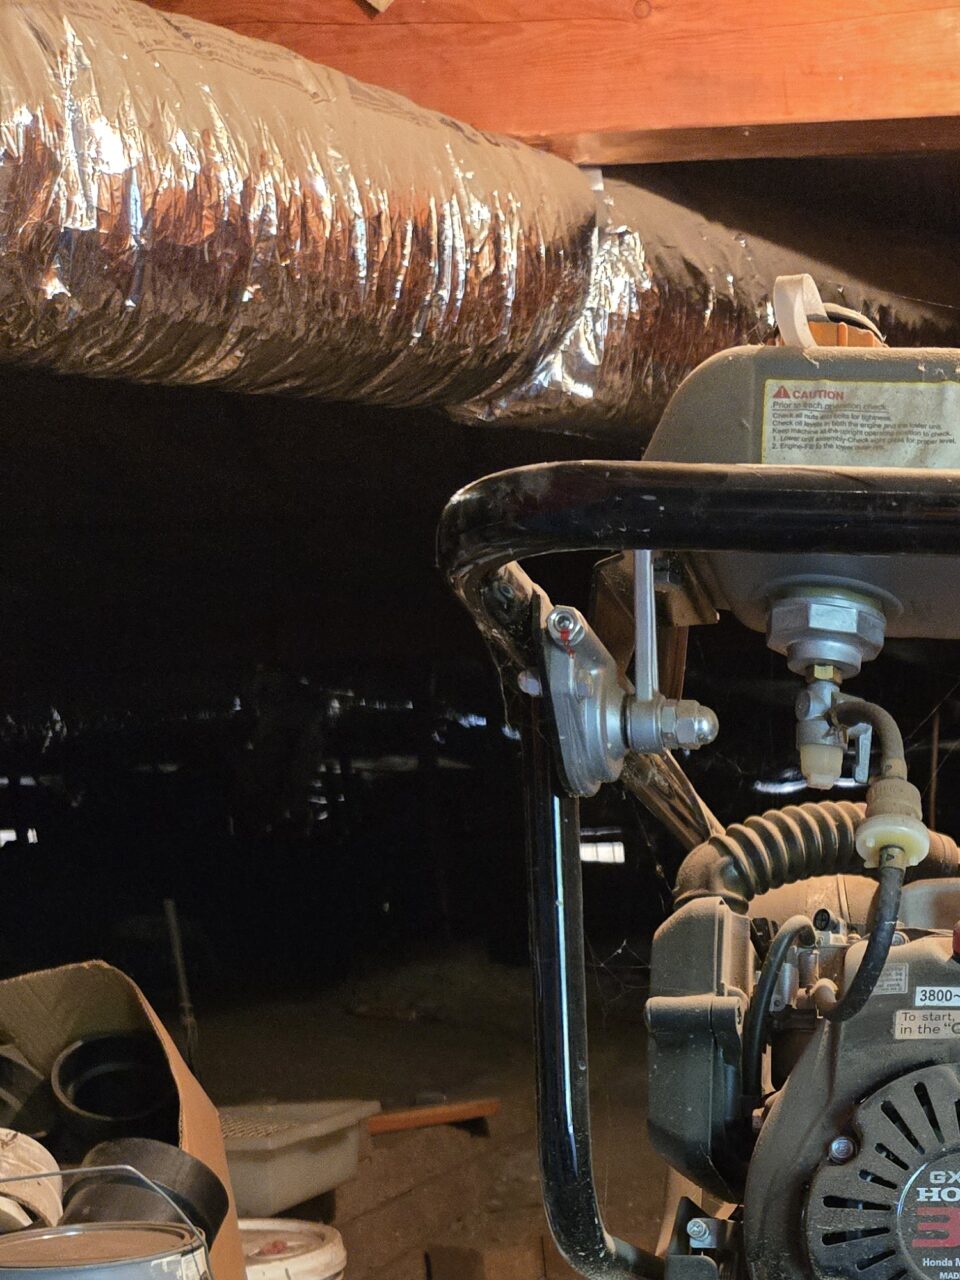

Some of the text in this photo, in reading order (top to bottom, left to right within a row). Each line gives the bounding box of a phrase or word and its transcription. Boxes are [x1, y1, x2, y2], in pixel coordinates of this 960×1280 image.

[792, 389, 844, 400] CAUTION
[901, 1011, 916, 1022] To
[922, 1012, 955, 1023] start,
[900, 1024, 912, 1035] in
[918, 1024, 940, 1035] the
[922, 1257, 953, 1267] Honda
